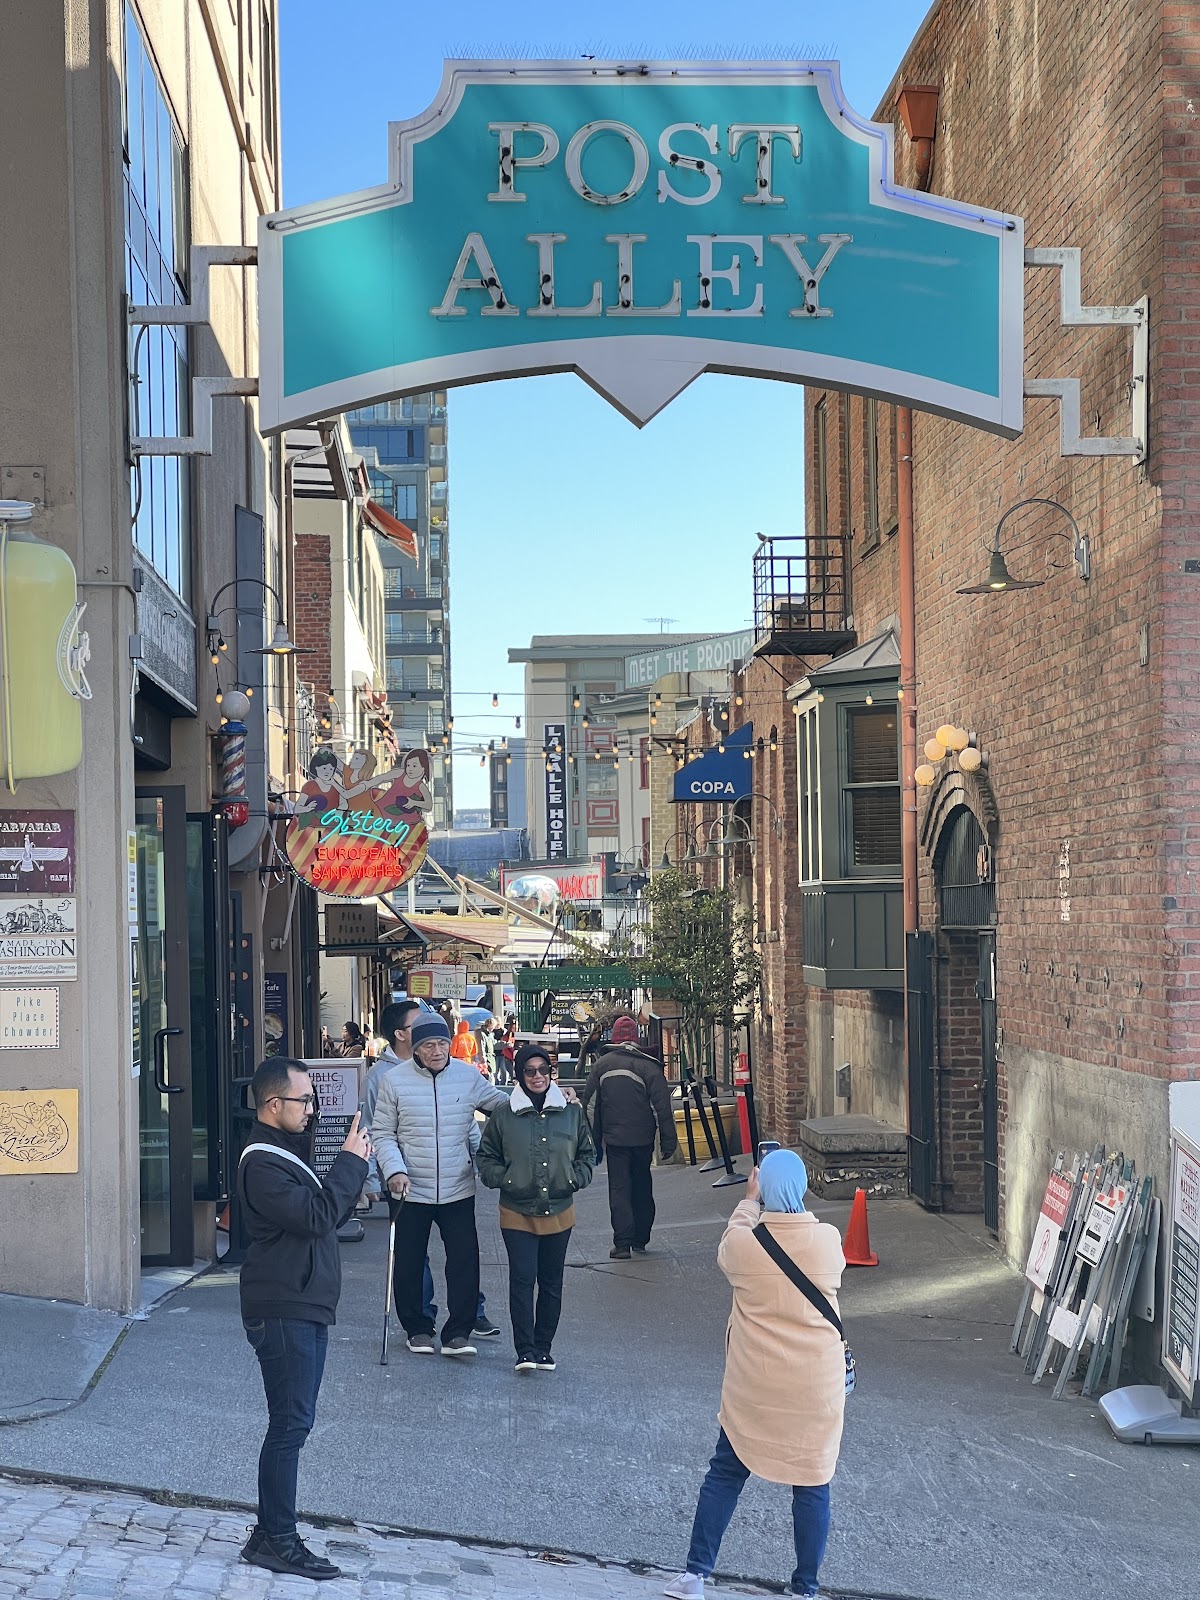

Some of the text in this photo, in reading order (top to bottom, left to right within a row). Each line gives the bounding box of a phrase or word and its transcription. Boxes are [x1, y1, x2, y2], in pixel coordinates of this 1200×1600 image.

[487, 120, 802, 206] POST
[429, 232, 854, 318] ALLEY
[629, 655, 660, 684] MEET
[665, 649, 689, 673] THE
[690, 781, 735, 794] COPA
[549, 808, 564, 859] HOTEL
[318, 847, 399, 861] EUROPEAN
[312, 864, 403, 880] SANDWICHES
[267, 983, 280, 991] cafe
[16, 996, 41, 1007] Pike
[12, 1011, 45, 1022] Place
[551, 1007, 570, 1015] Pasta
[4, 1026, 53, 1037] Chowder
